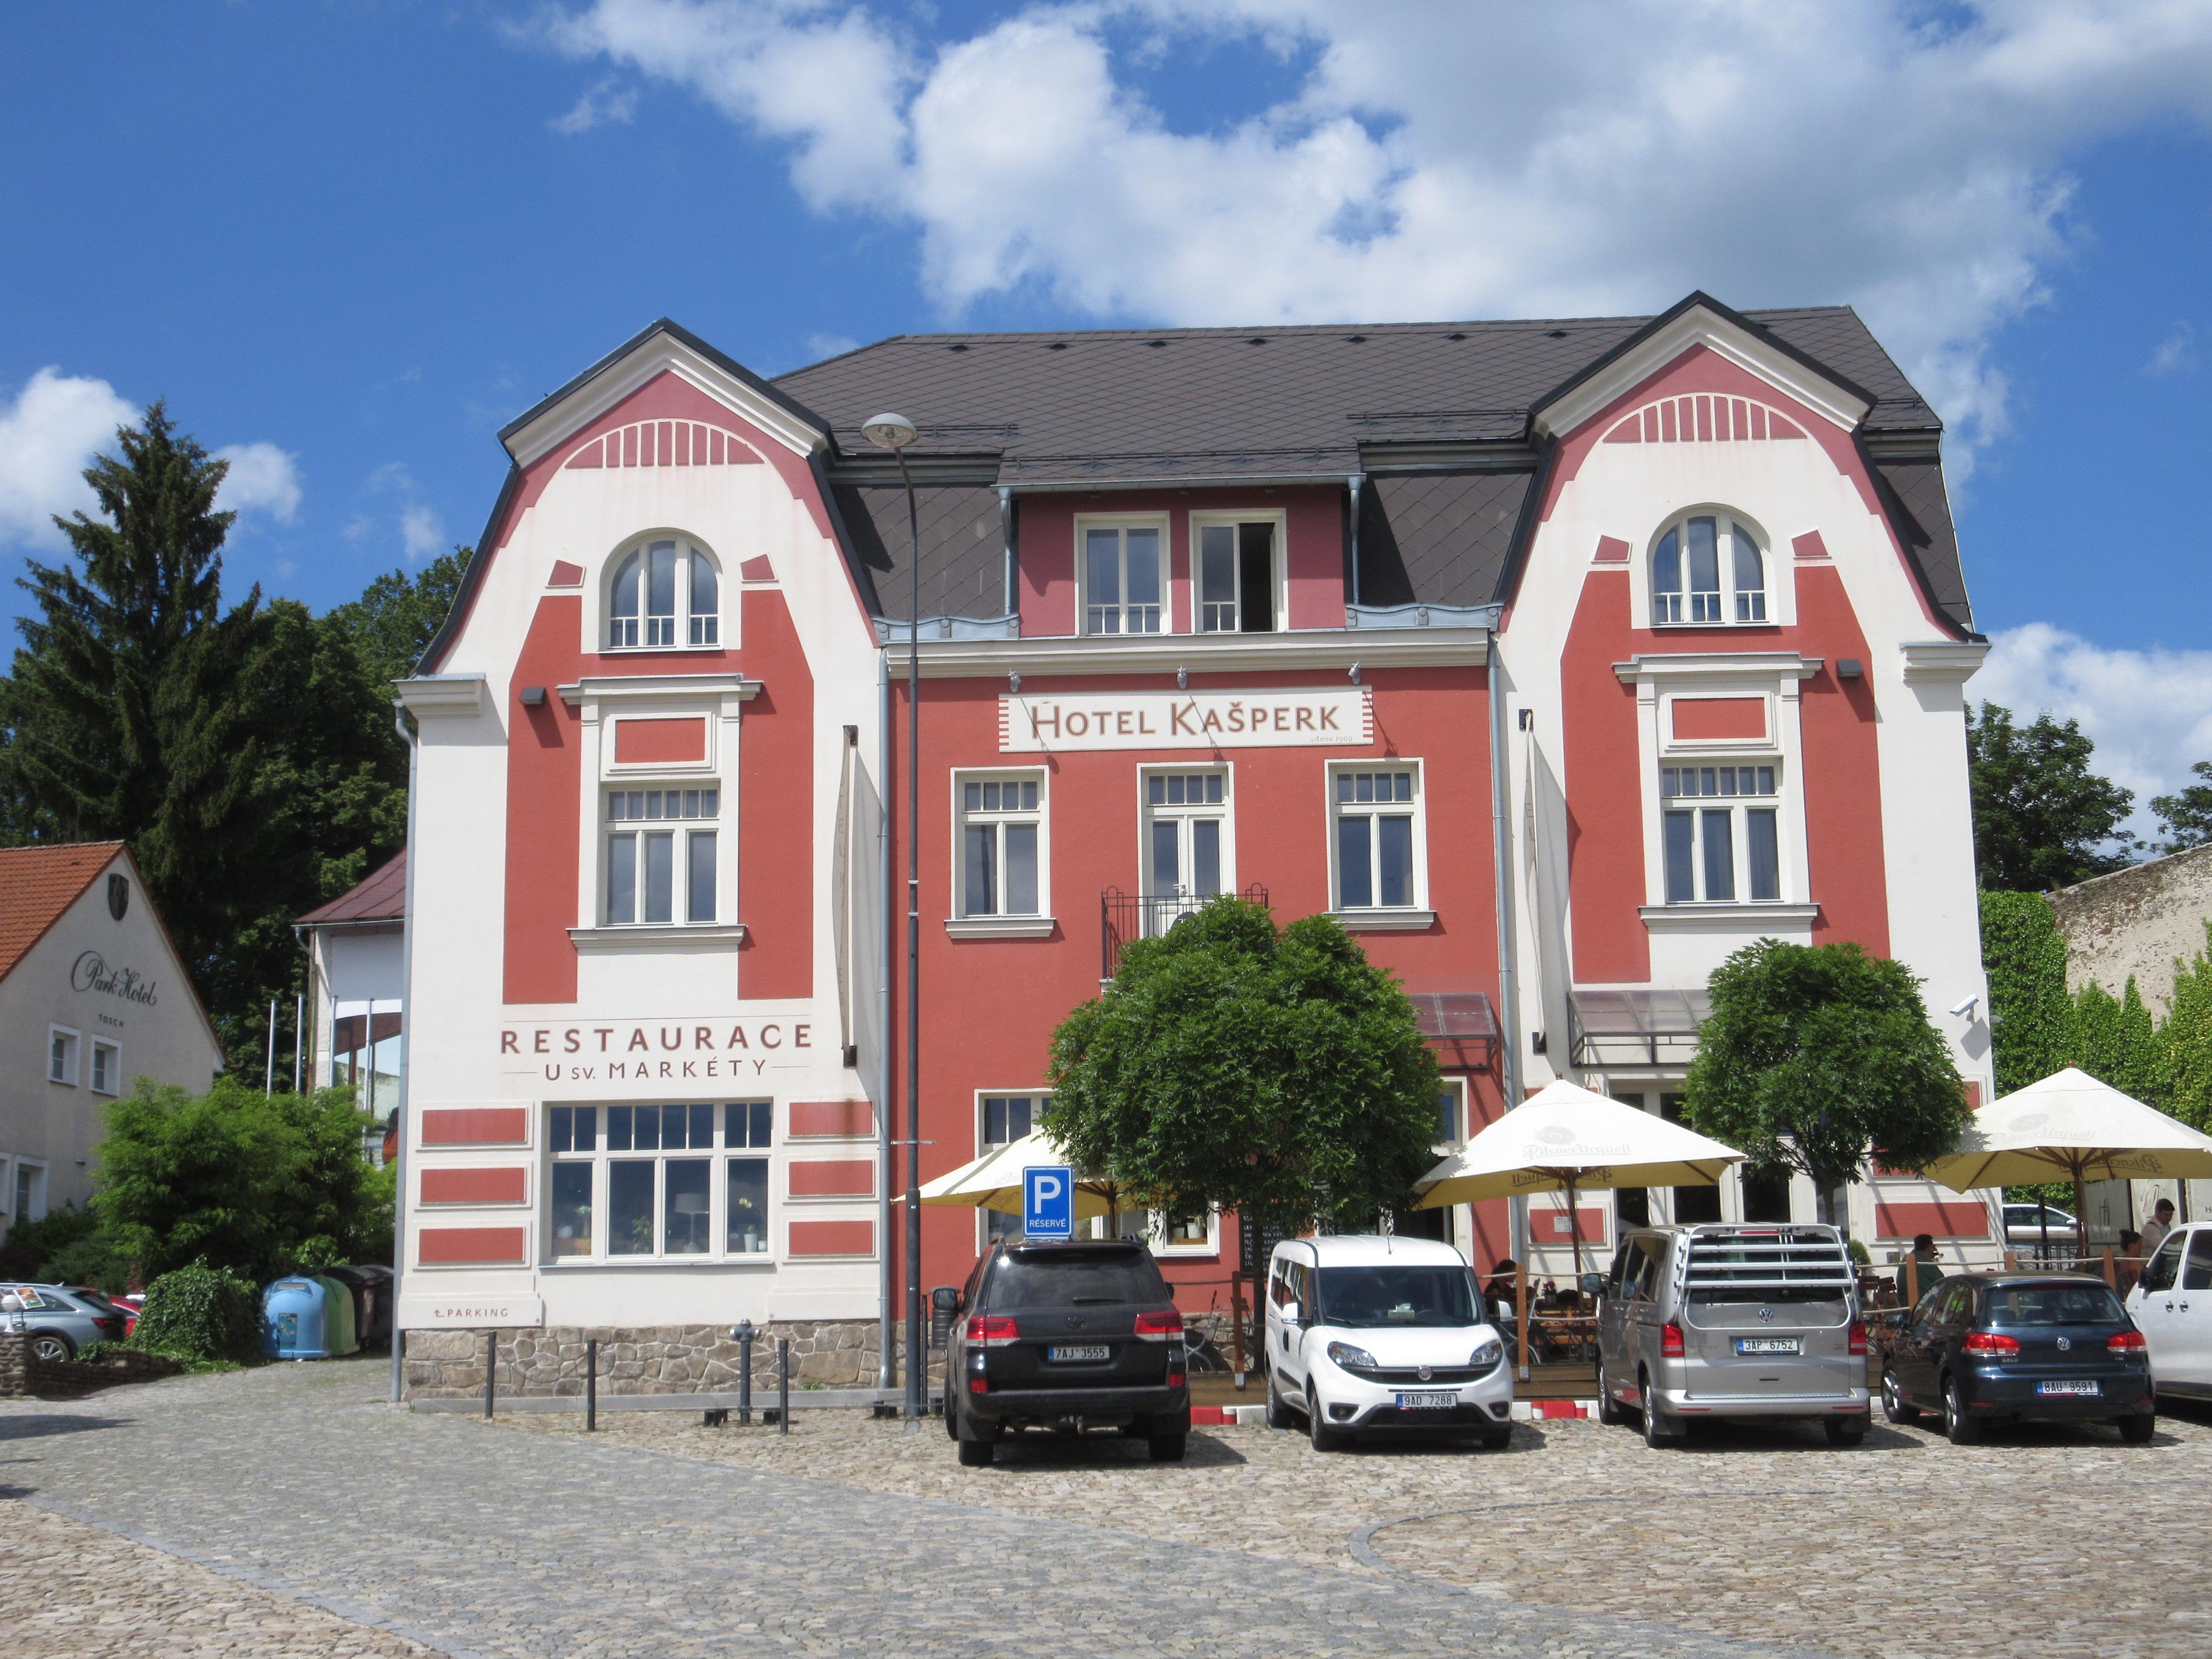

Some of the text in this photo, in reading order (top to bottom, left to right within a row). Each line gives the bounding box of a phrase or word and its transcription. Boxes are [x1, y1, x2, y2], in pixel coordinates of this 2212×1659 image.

[1031, 701, 1341, 739] HOTEL KAŠPERK
[71, 951, 157, 1006] Park Hotel
[501, 1024, 811, 1054] RESTAURACE
[546, 1064, 560, 1081] U
[609, 1056, 766, 1079] MARKÉTY
[1523, 1144, 1631, 1161] Pilsner Urquell
[1034, 1176, 1061, 1214] P
[1030, 1218, 1066, 1227] RÉSERVÉ
[447, 1309, 508, 1317] PARKING
[1745, 1340, 1762, 1350] 3AP
[1770, 1339, 1793, 1349] 6752
[1056, 1348, 1105, 1358] 7AJ 3555
[2045, 1382, 2062, 1392] 8AU
[2070, 1382, 2092, 1391] 9591
[1404, 1395, 1452, 1406] 9AD 7288
